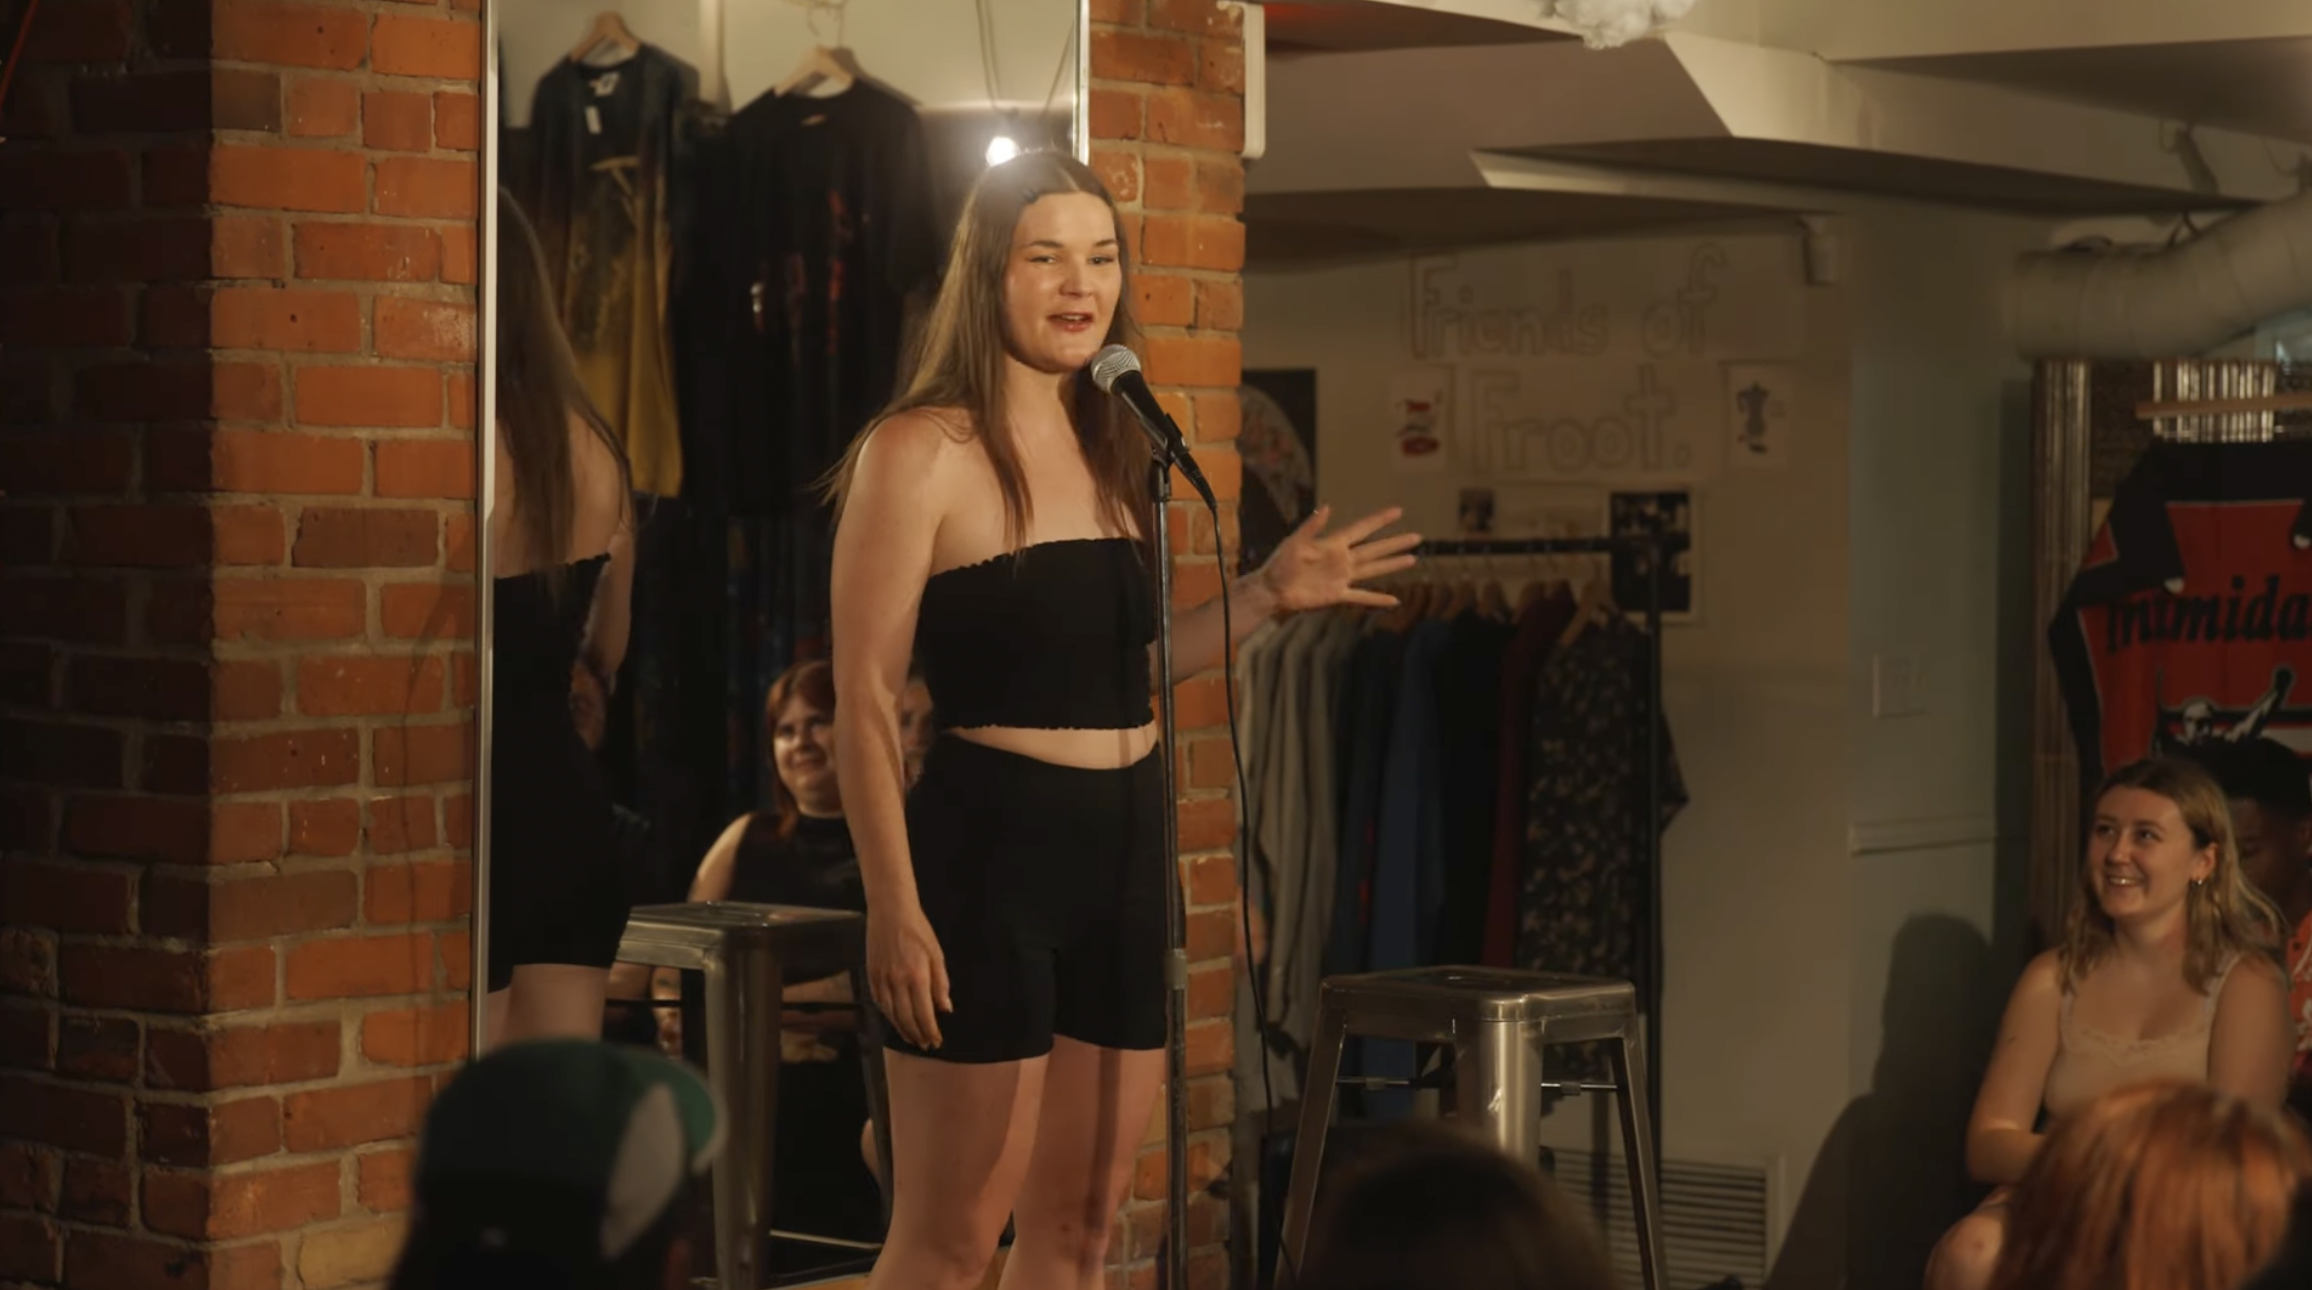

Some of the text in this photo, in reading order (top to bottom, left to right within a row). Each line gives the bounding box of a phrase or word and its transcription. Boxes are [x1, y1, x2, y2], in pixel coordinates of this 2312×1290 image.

[1410, 241, 1727, 360] Friends of
[1470, 363, 1691, 474] Froot.
